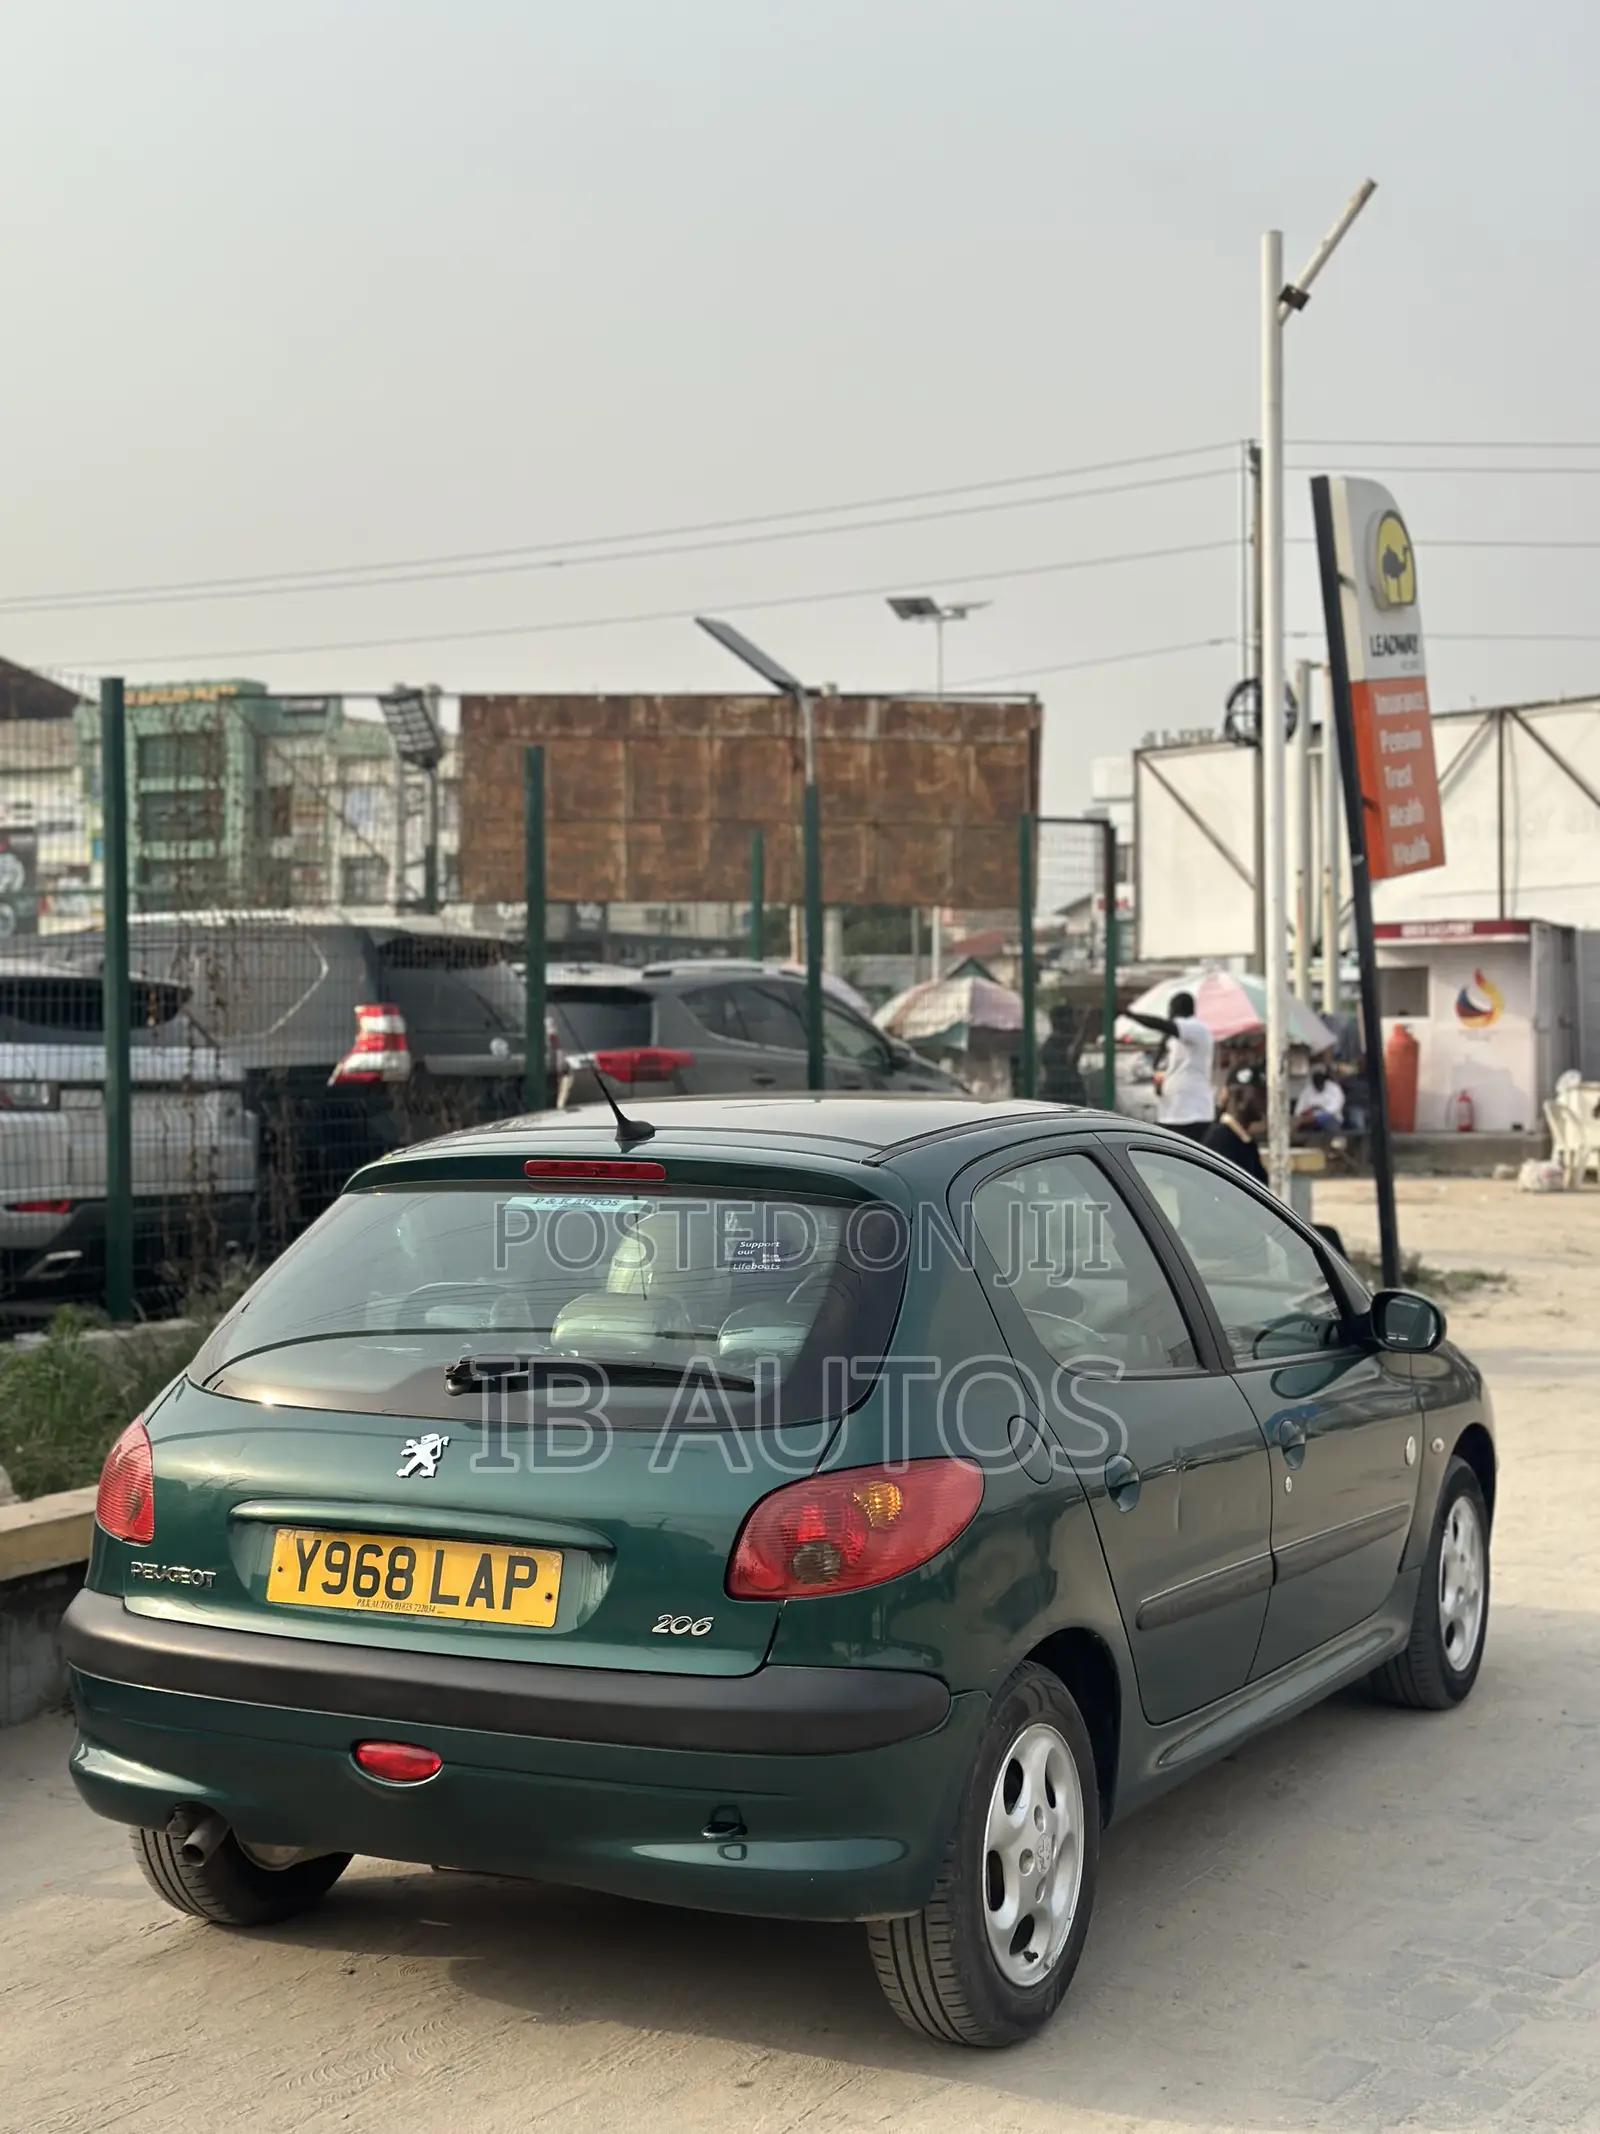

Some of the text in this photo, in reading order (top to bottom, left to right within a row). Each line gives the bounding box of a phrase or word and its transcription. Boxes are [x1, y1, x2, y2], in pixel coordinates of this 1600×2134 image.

[1384, 764, 1413, 790] Trust
[739, 1241, 781, 1249] Support
[130, 1561, 217, 1587] PEUGEOT
[297, 1538, 538, 1611] Y968 LAP
[652, 1614, 715, 1636] 206
